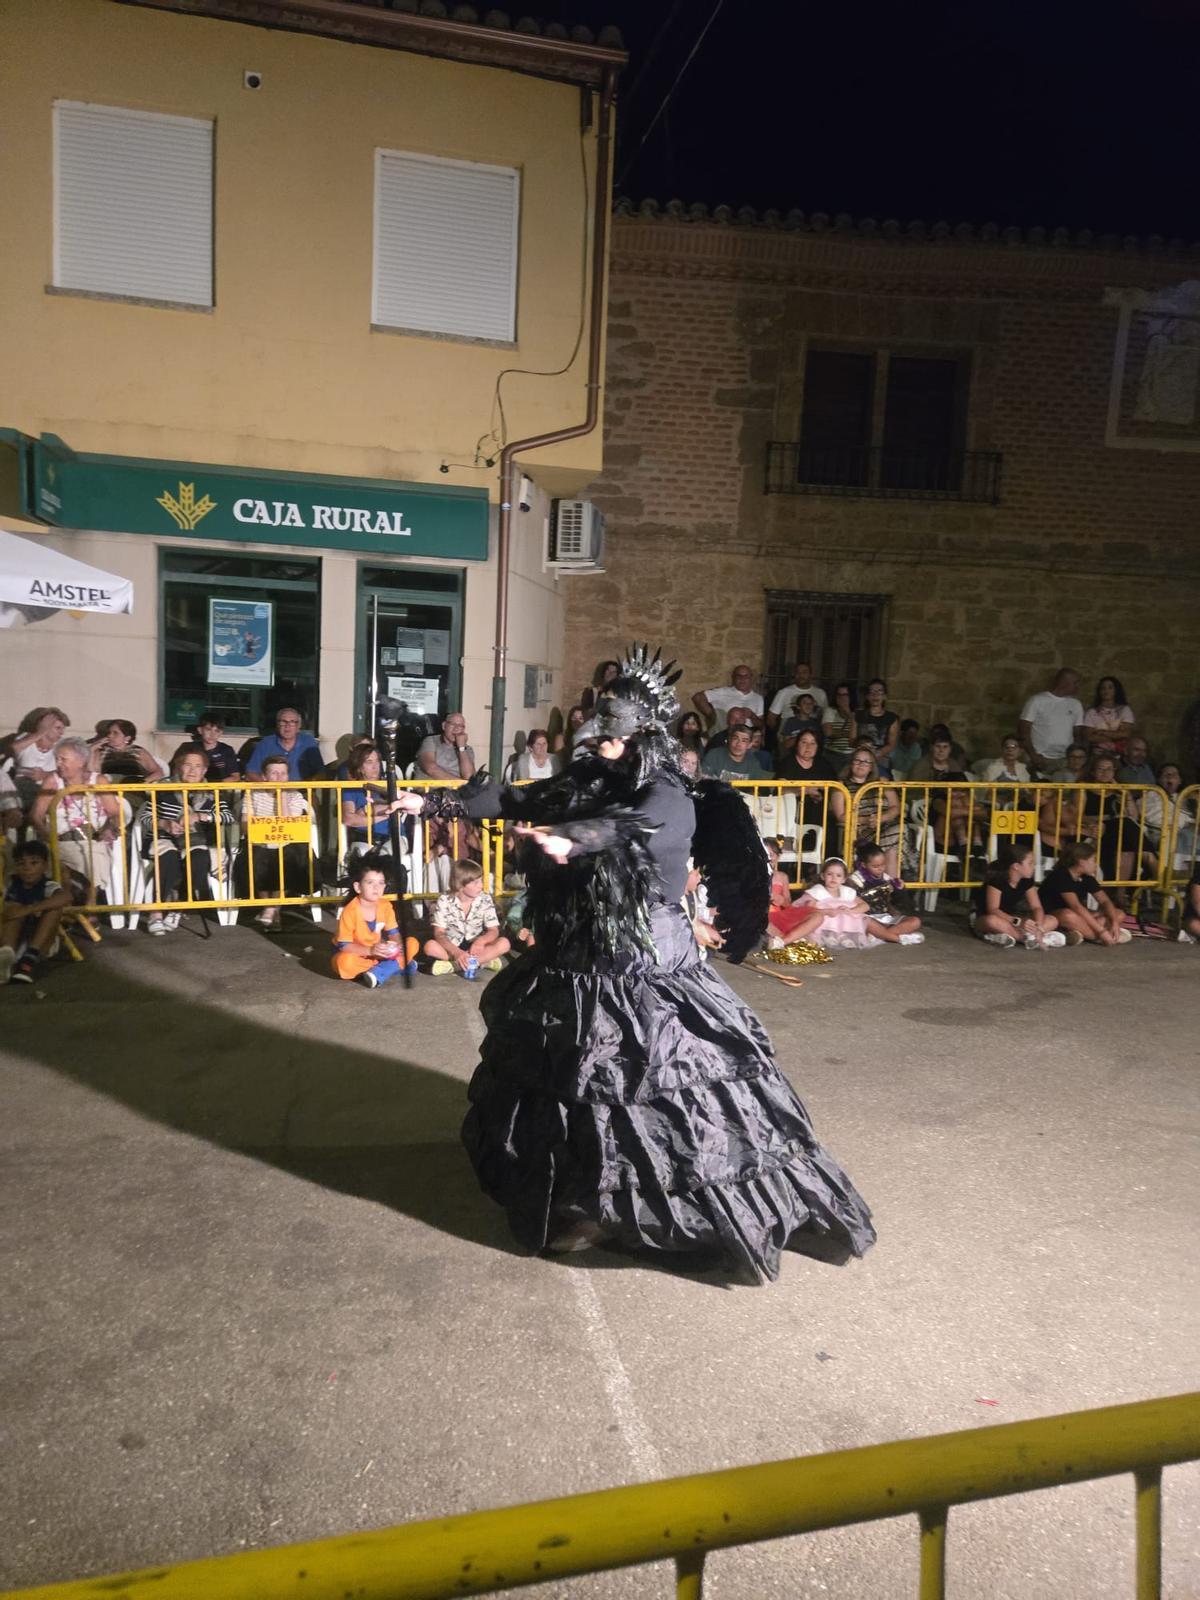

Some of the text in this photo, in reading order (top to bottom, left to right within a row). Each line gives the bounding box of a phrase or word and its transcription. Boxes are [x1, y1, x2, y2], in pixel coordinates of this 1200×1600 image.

[233, 498, 412, 536] CAJA RURAL
[29, 579, 111, 601] AMSTEL
[271, 825, 284, 833] DE
